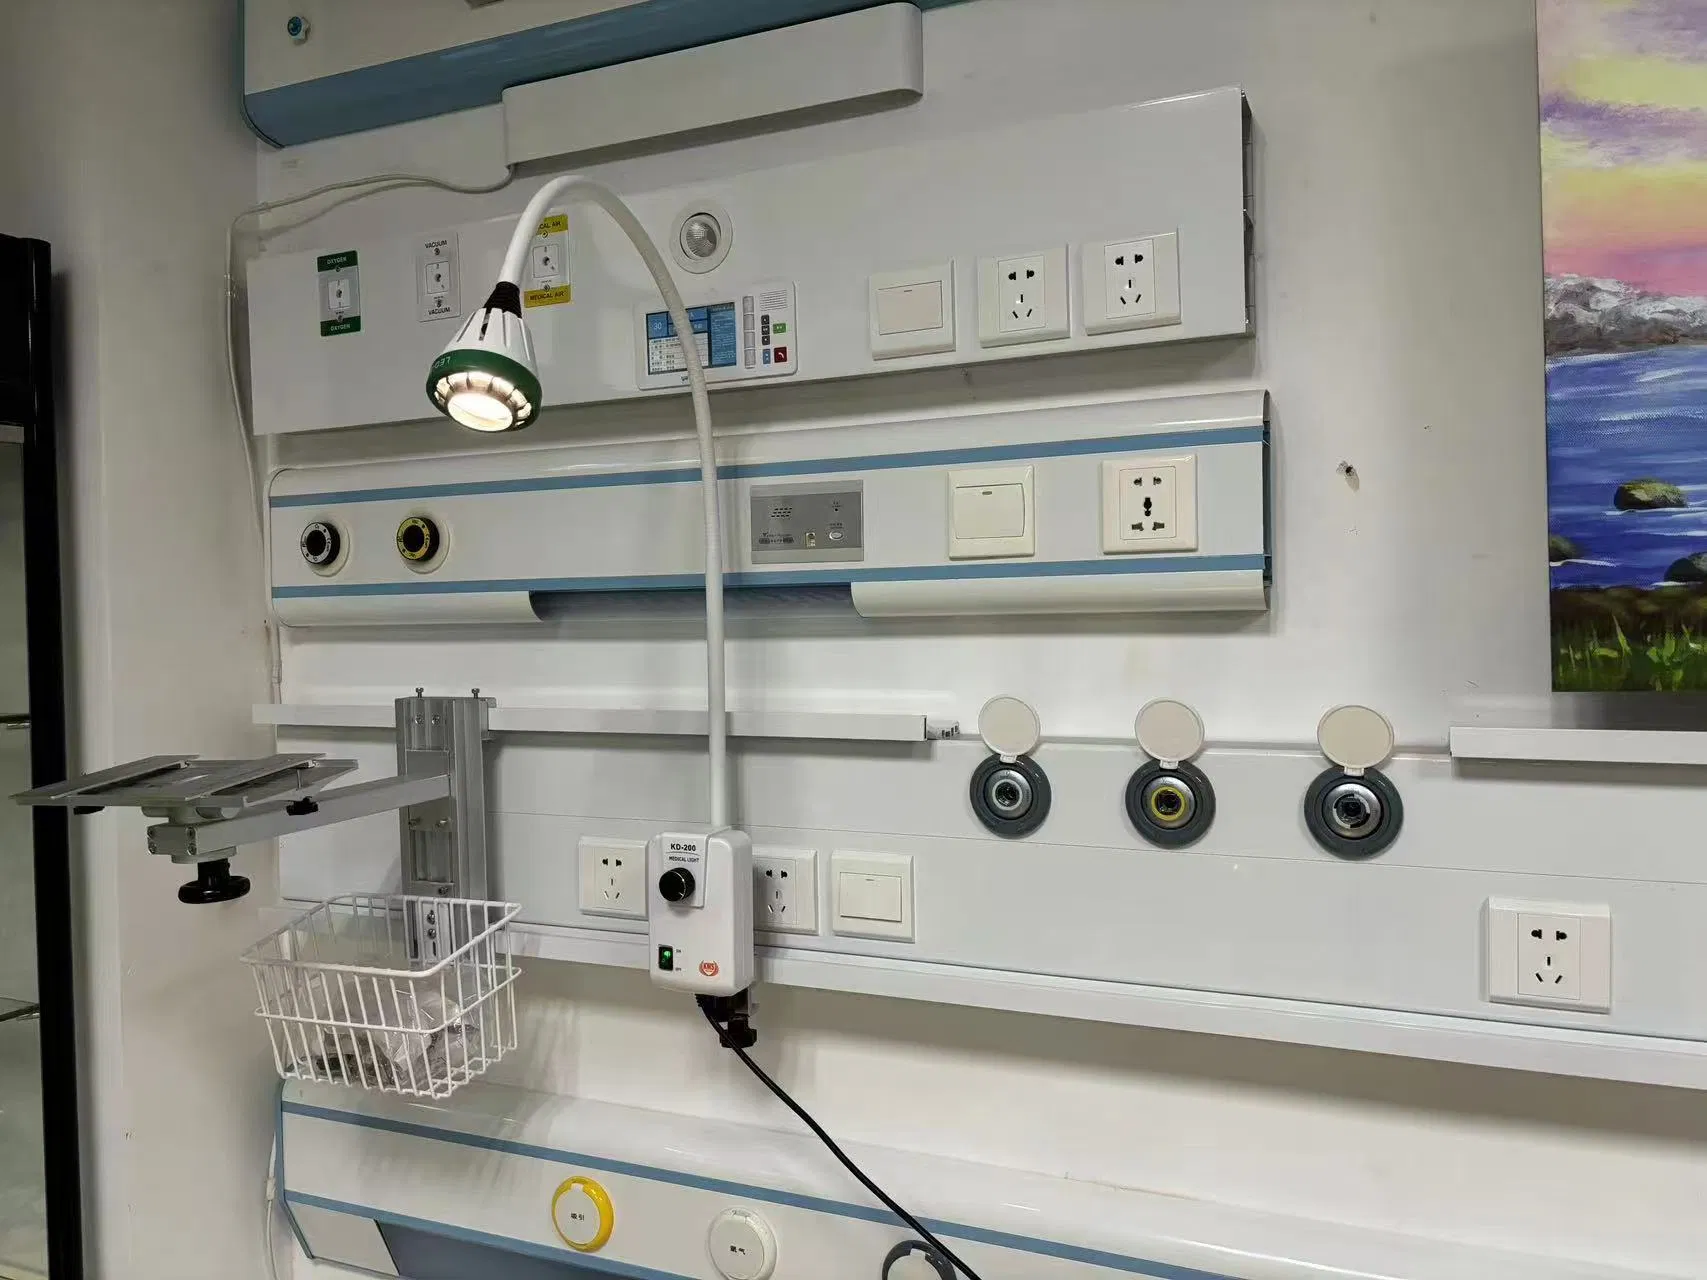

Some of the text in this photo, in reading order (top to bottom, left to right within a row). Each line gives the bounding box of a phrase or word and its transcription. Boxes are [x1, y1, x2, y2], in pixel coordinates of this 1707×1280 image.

[425, 240, 447, 249] VACUUM
[327, 256, 347, 265] OXYGEN
[530, 292, 553, 301] MEDICAL
[428, 307, 450, 316] VACUUM
[330, 323, 351, 332] OXYGEN
[670, 843, 697, 852] KD-200
